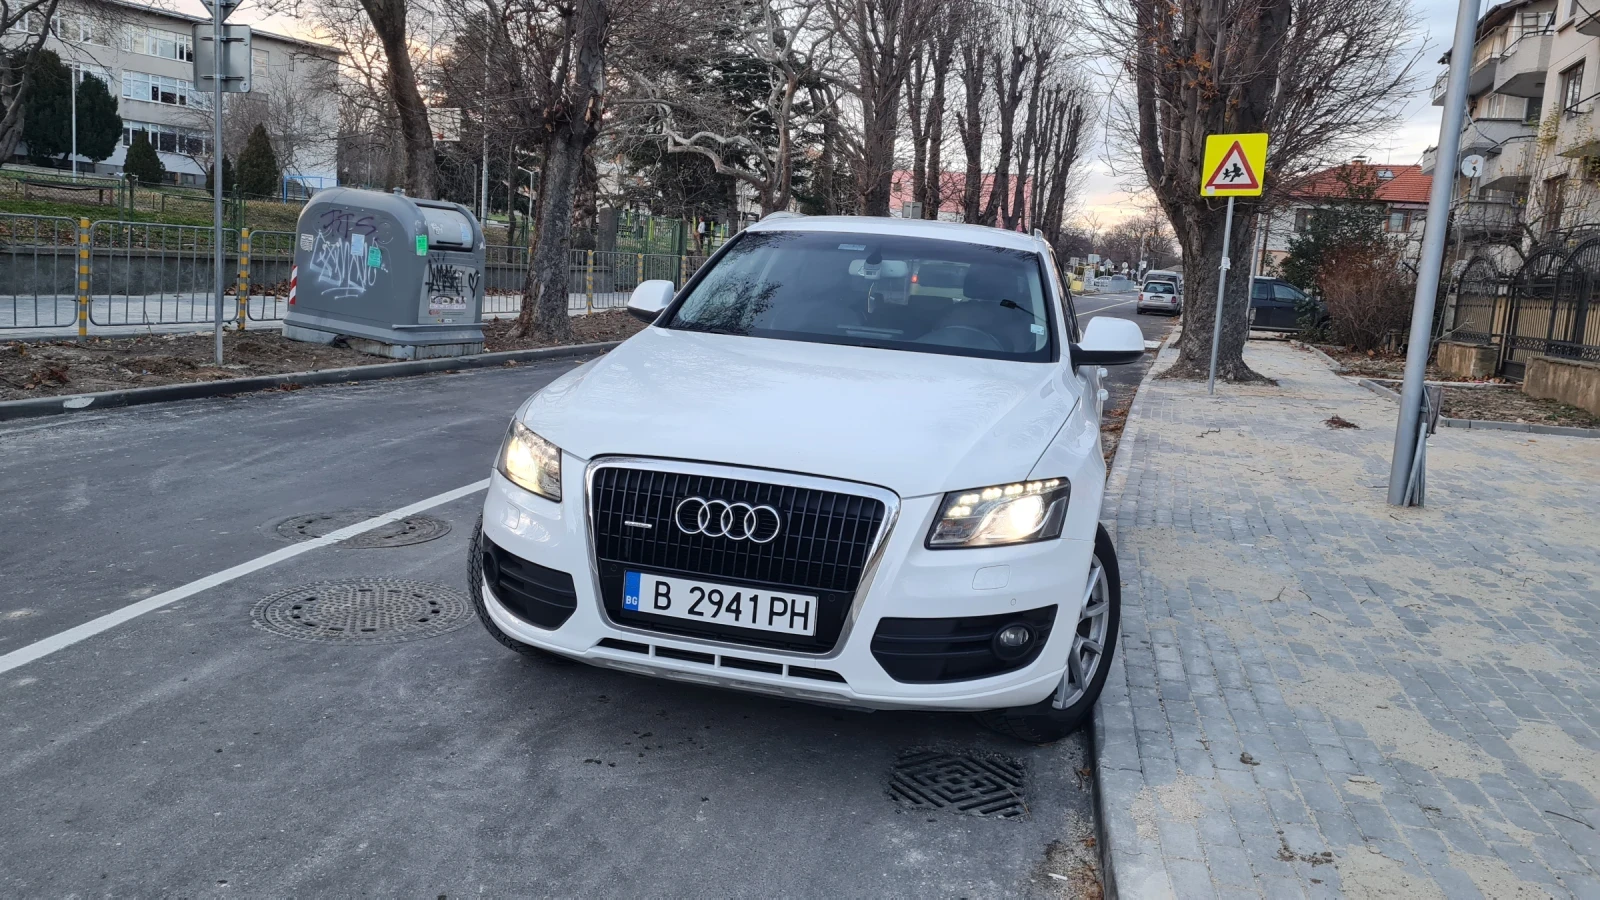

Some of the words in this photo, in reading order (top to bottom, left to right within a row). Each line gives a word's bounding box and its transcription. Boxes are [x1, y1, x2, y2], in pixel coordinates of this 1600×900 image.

[625, 595, 638, 606] BG
[653, 580, 672, 611] B
[687, 586, 759, 624] 2941
[768, 596, 810, 631] PH
